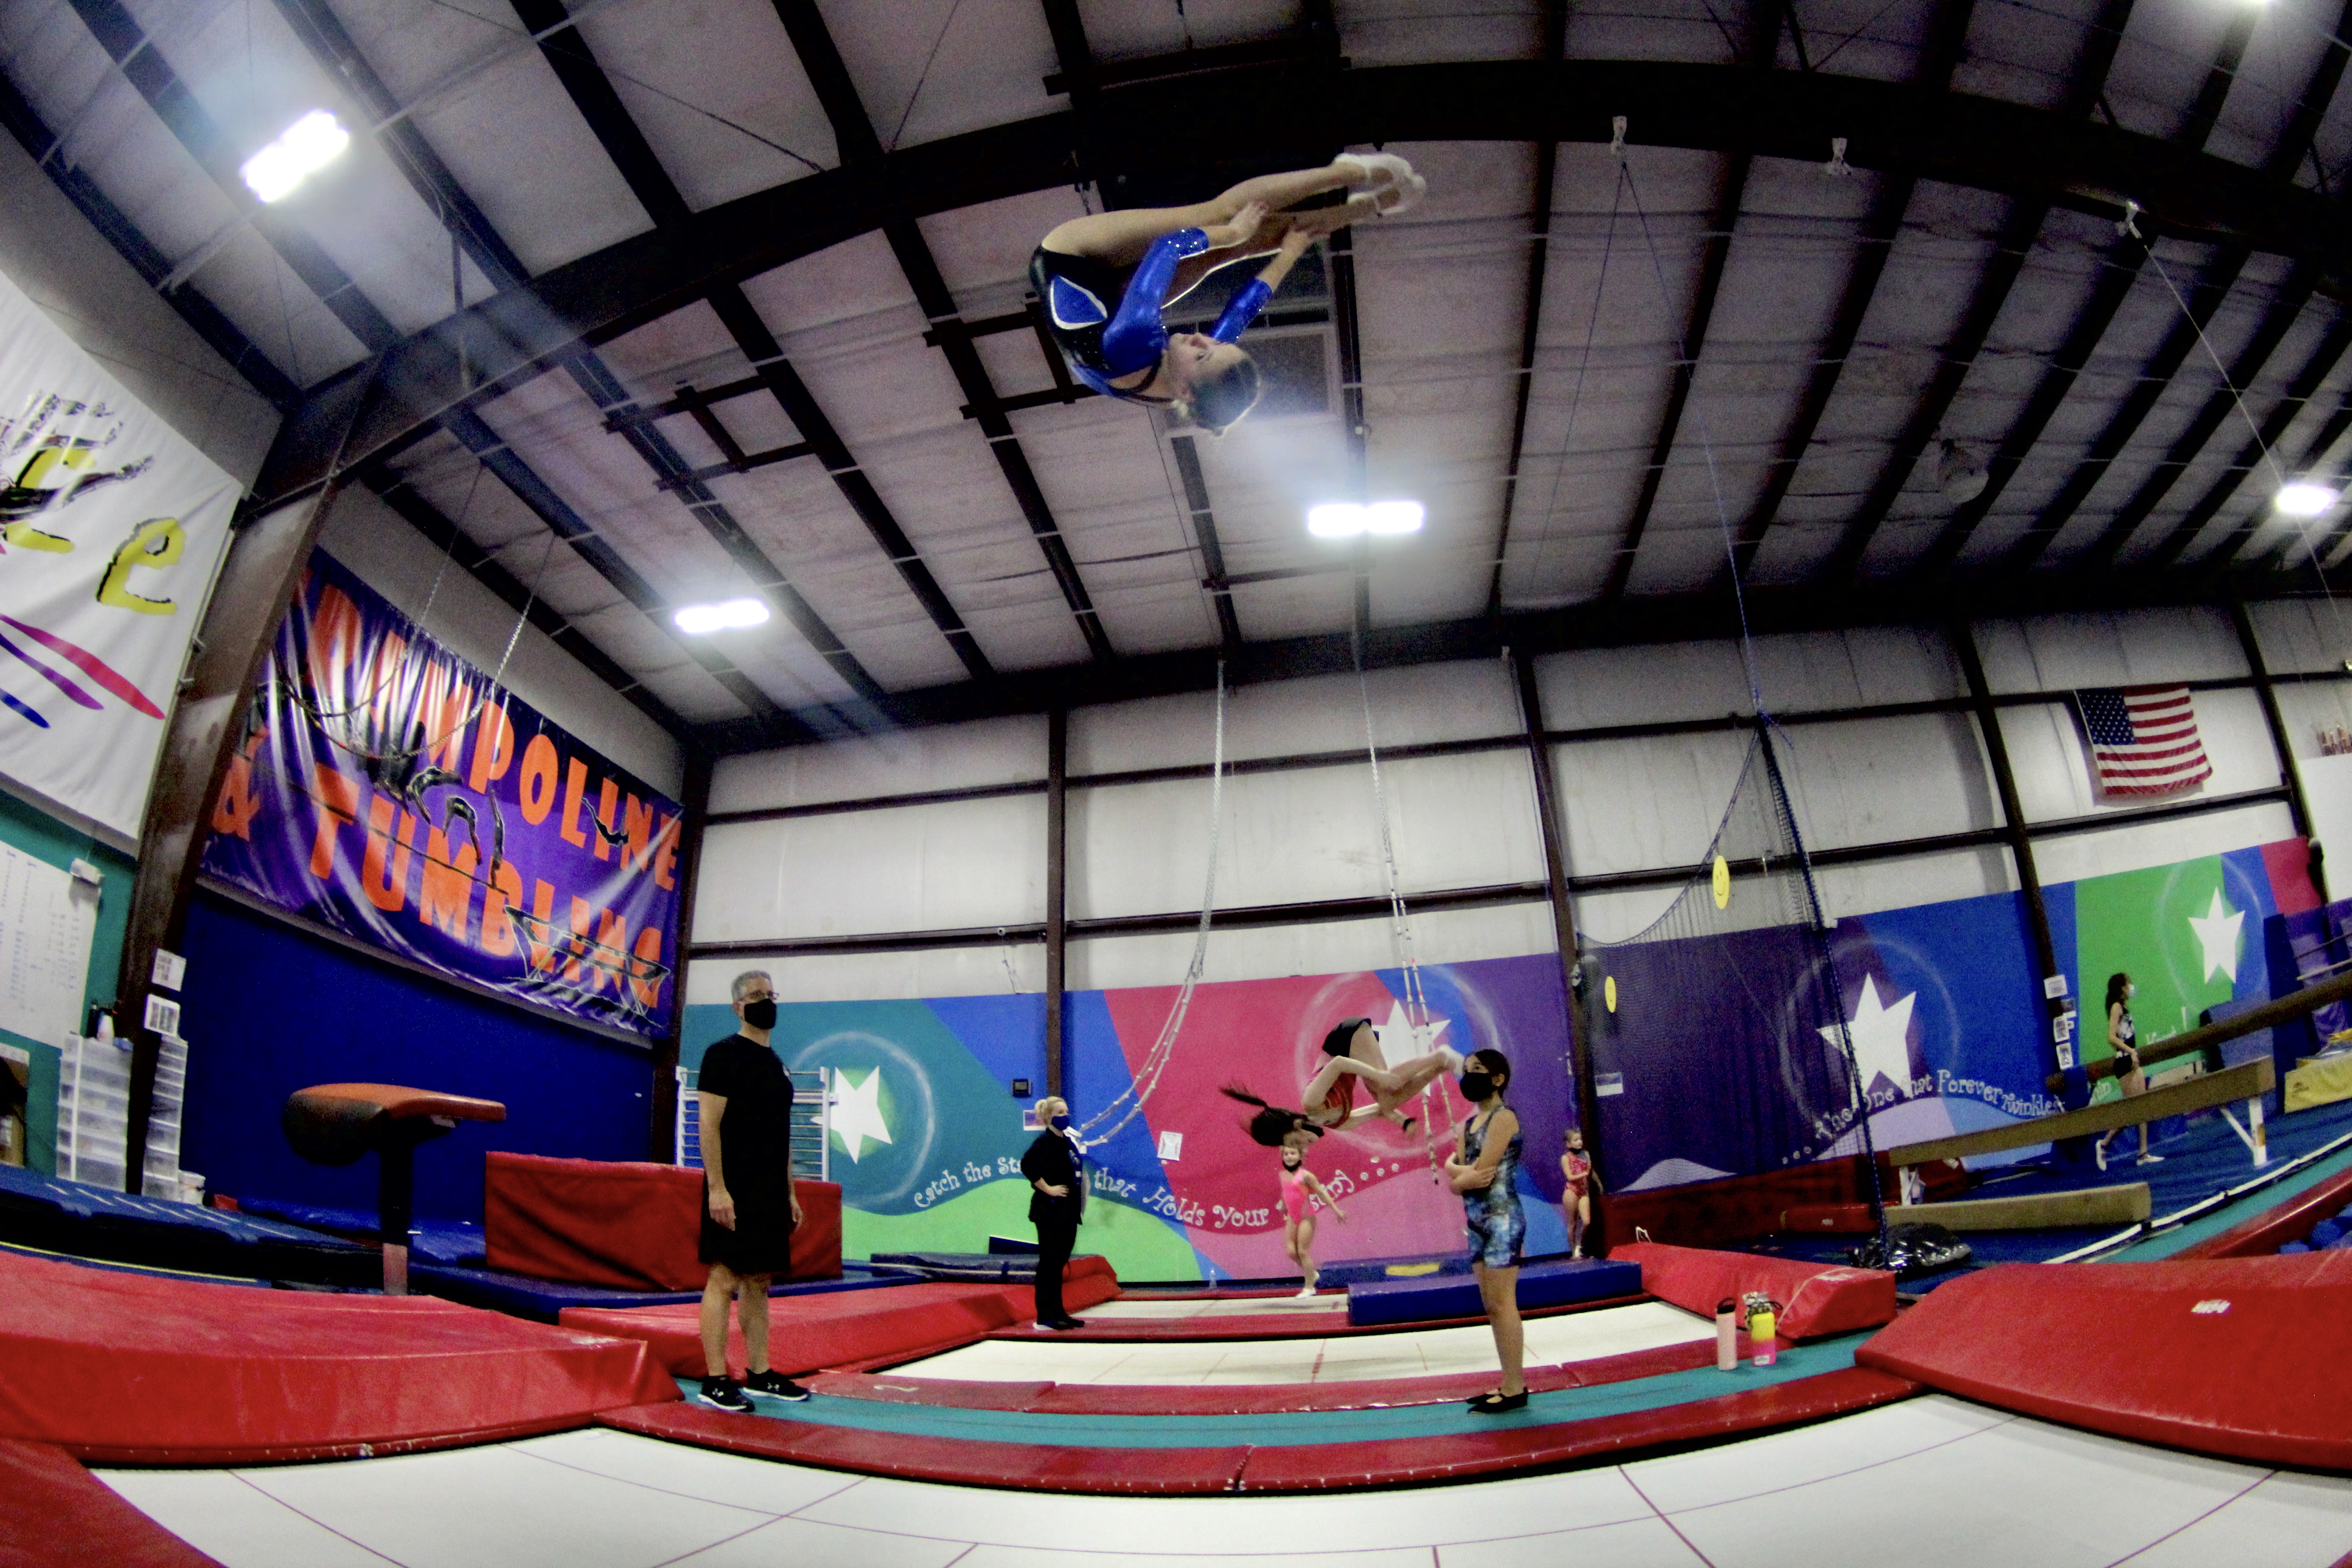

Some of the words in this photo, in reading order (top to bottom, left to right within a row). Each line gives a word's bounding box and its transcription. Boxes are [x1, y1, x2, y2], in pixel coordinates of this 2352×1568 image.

[290, 563, 681, 891] RAMPOLINE
[309, 761, 662, 1008] TUMBLING
[1937, 1069, 2003, 1104] Forever
[914, 1169, 961, 1208] Catch
[963, 1161, 992, 1182] the
[1094, 1167, 1137, 1198] that
[1142, 1186, 1205, 1226] Holds
[1212, 1205, 1269, 1229] Your
